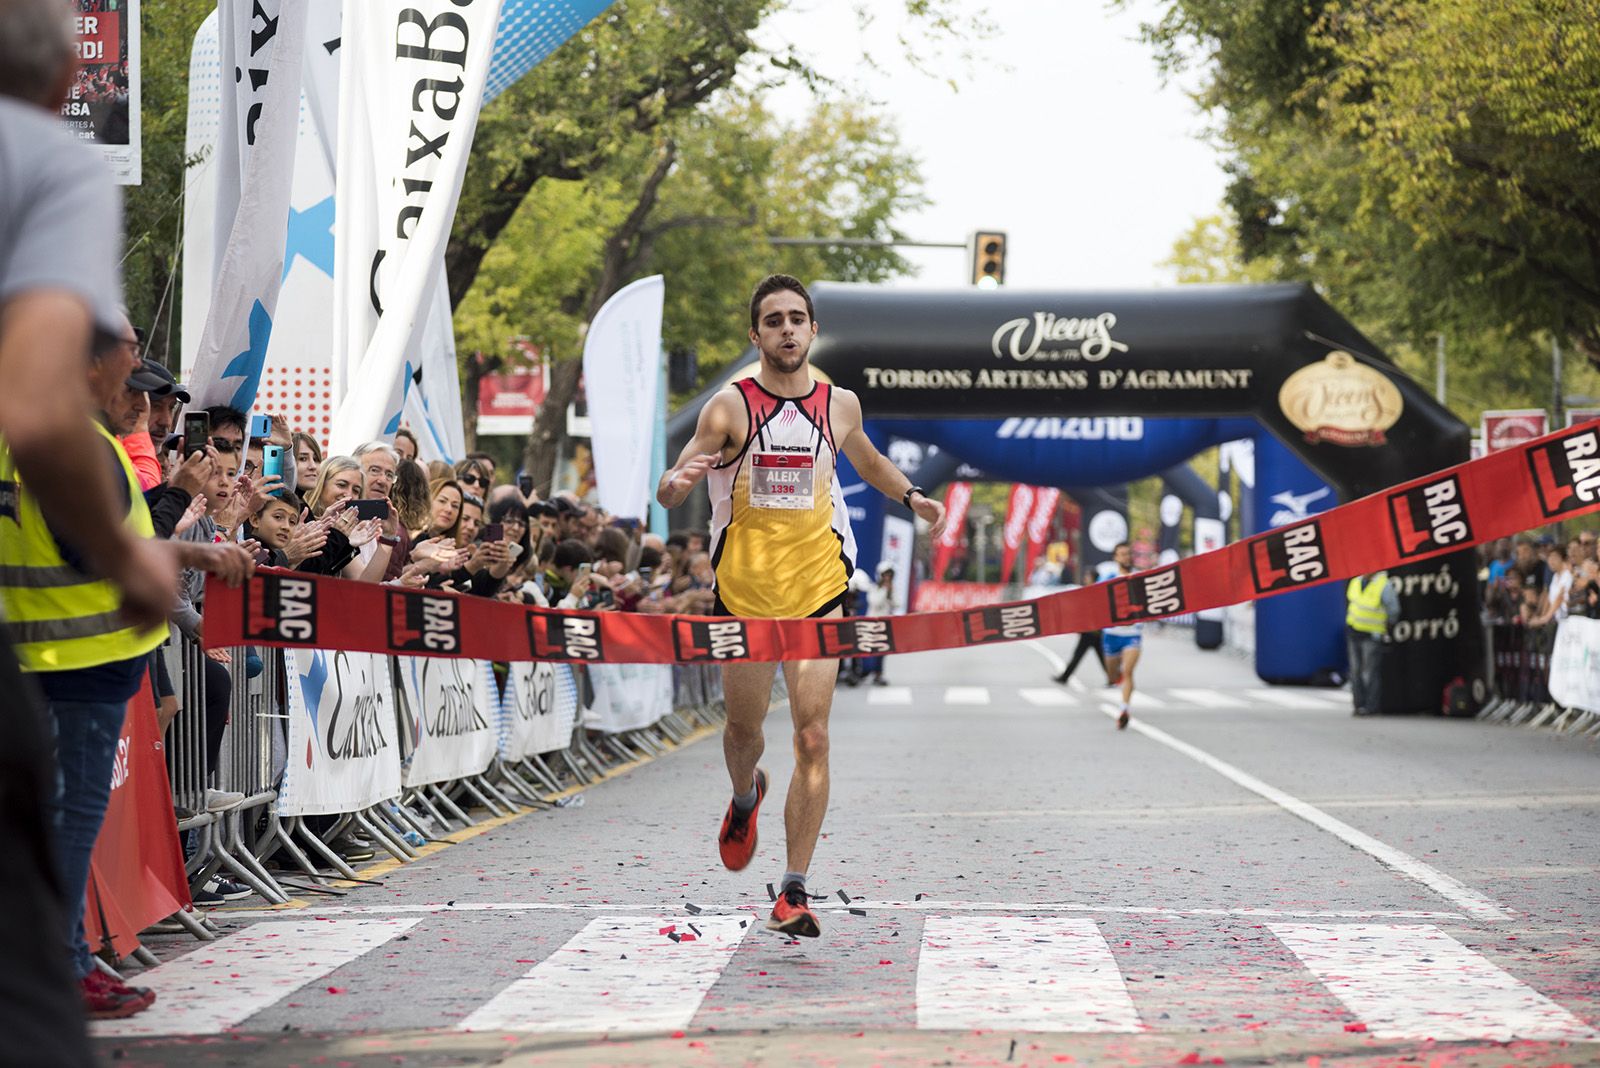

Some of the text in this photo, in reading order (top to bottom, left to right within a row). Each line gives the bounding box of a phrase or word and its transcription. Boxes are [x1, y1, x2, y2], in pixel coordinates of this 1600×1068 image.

[73, 16, 98, 35] ER
[72, 41, 104, 59] RD!
[61, 102, 90, 116] RSA
[991, 312, 1129, 361] Vicens
[863, 367, 1253, 390] TORRONS ARTESANS D'AGRAMUNT
[766, 470, 801, 483] ALEIX
[771, 484, 795, 494] 1336
[1424, 479, 1467, 544] RAC
[1283, 525, 1323, 582] RAC
[1144, 570, 1180, 615] RAC
[1390, 563, 1460, 598] orró,
[279, 579, 313, 640] RAC
[423, 597, 456, 651] RAC
[1001, 604, 1036, 638] RAC
[1384, 608, 1460, 643] orró
[563, 617, 599, 660] RAC
[708, 621, 745, 660] RAC
[855, 621, 891, 653] RAC
